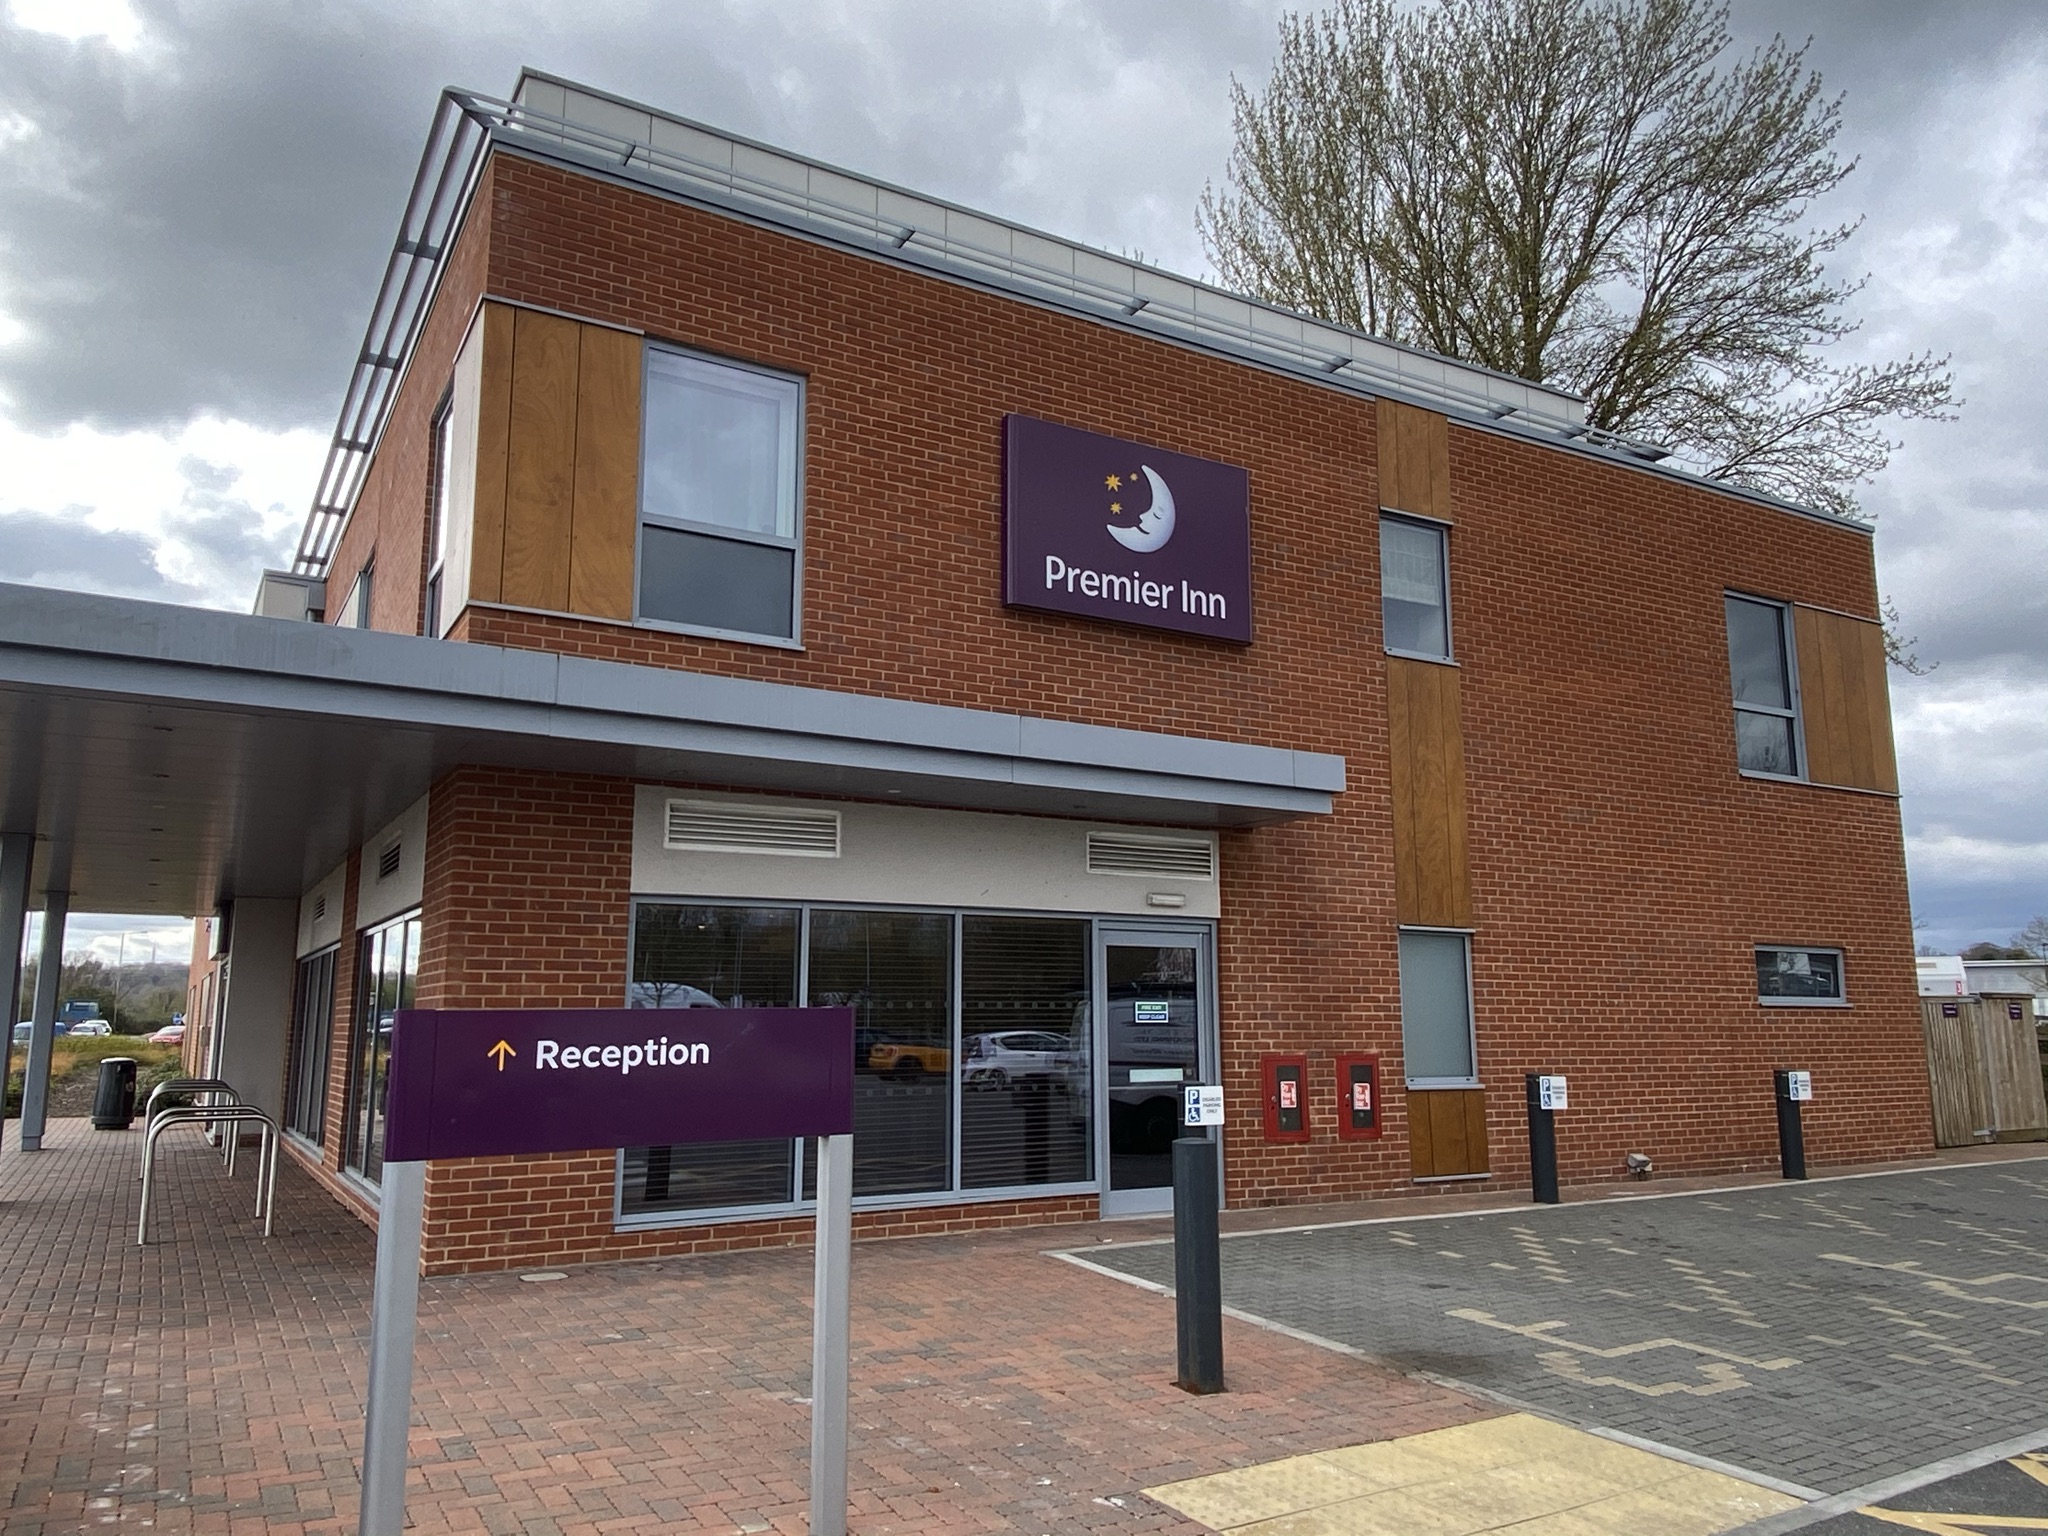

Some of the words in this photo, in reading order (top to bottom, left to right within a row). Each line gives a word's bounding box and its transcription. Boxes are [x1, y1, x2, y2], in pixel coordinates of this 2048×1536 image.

[1045, 555, 1174, 610] Premier
[1182, 580, 1226, 619] Inn
[535, 1036, 710, 1075] Reception
[1190, 1090, 1198, 1105] P
